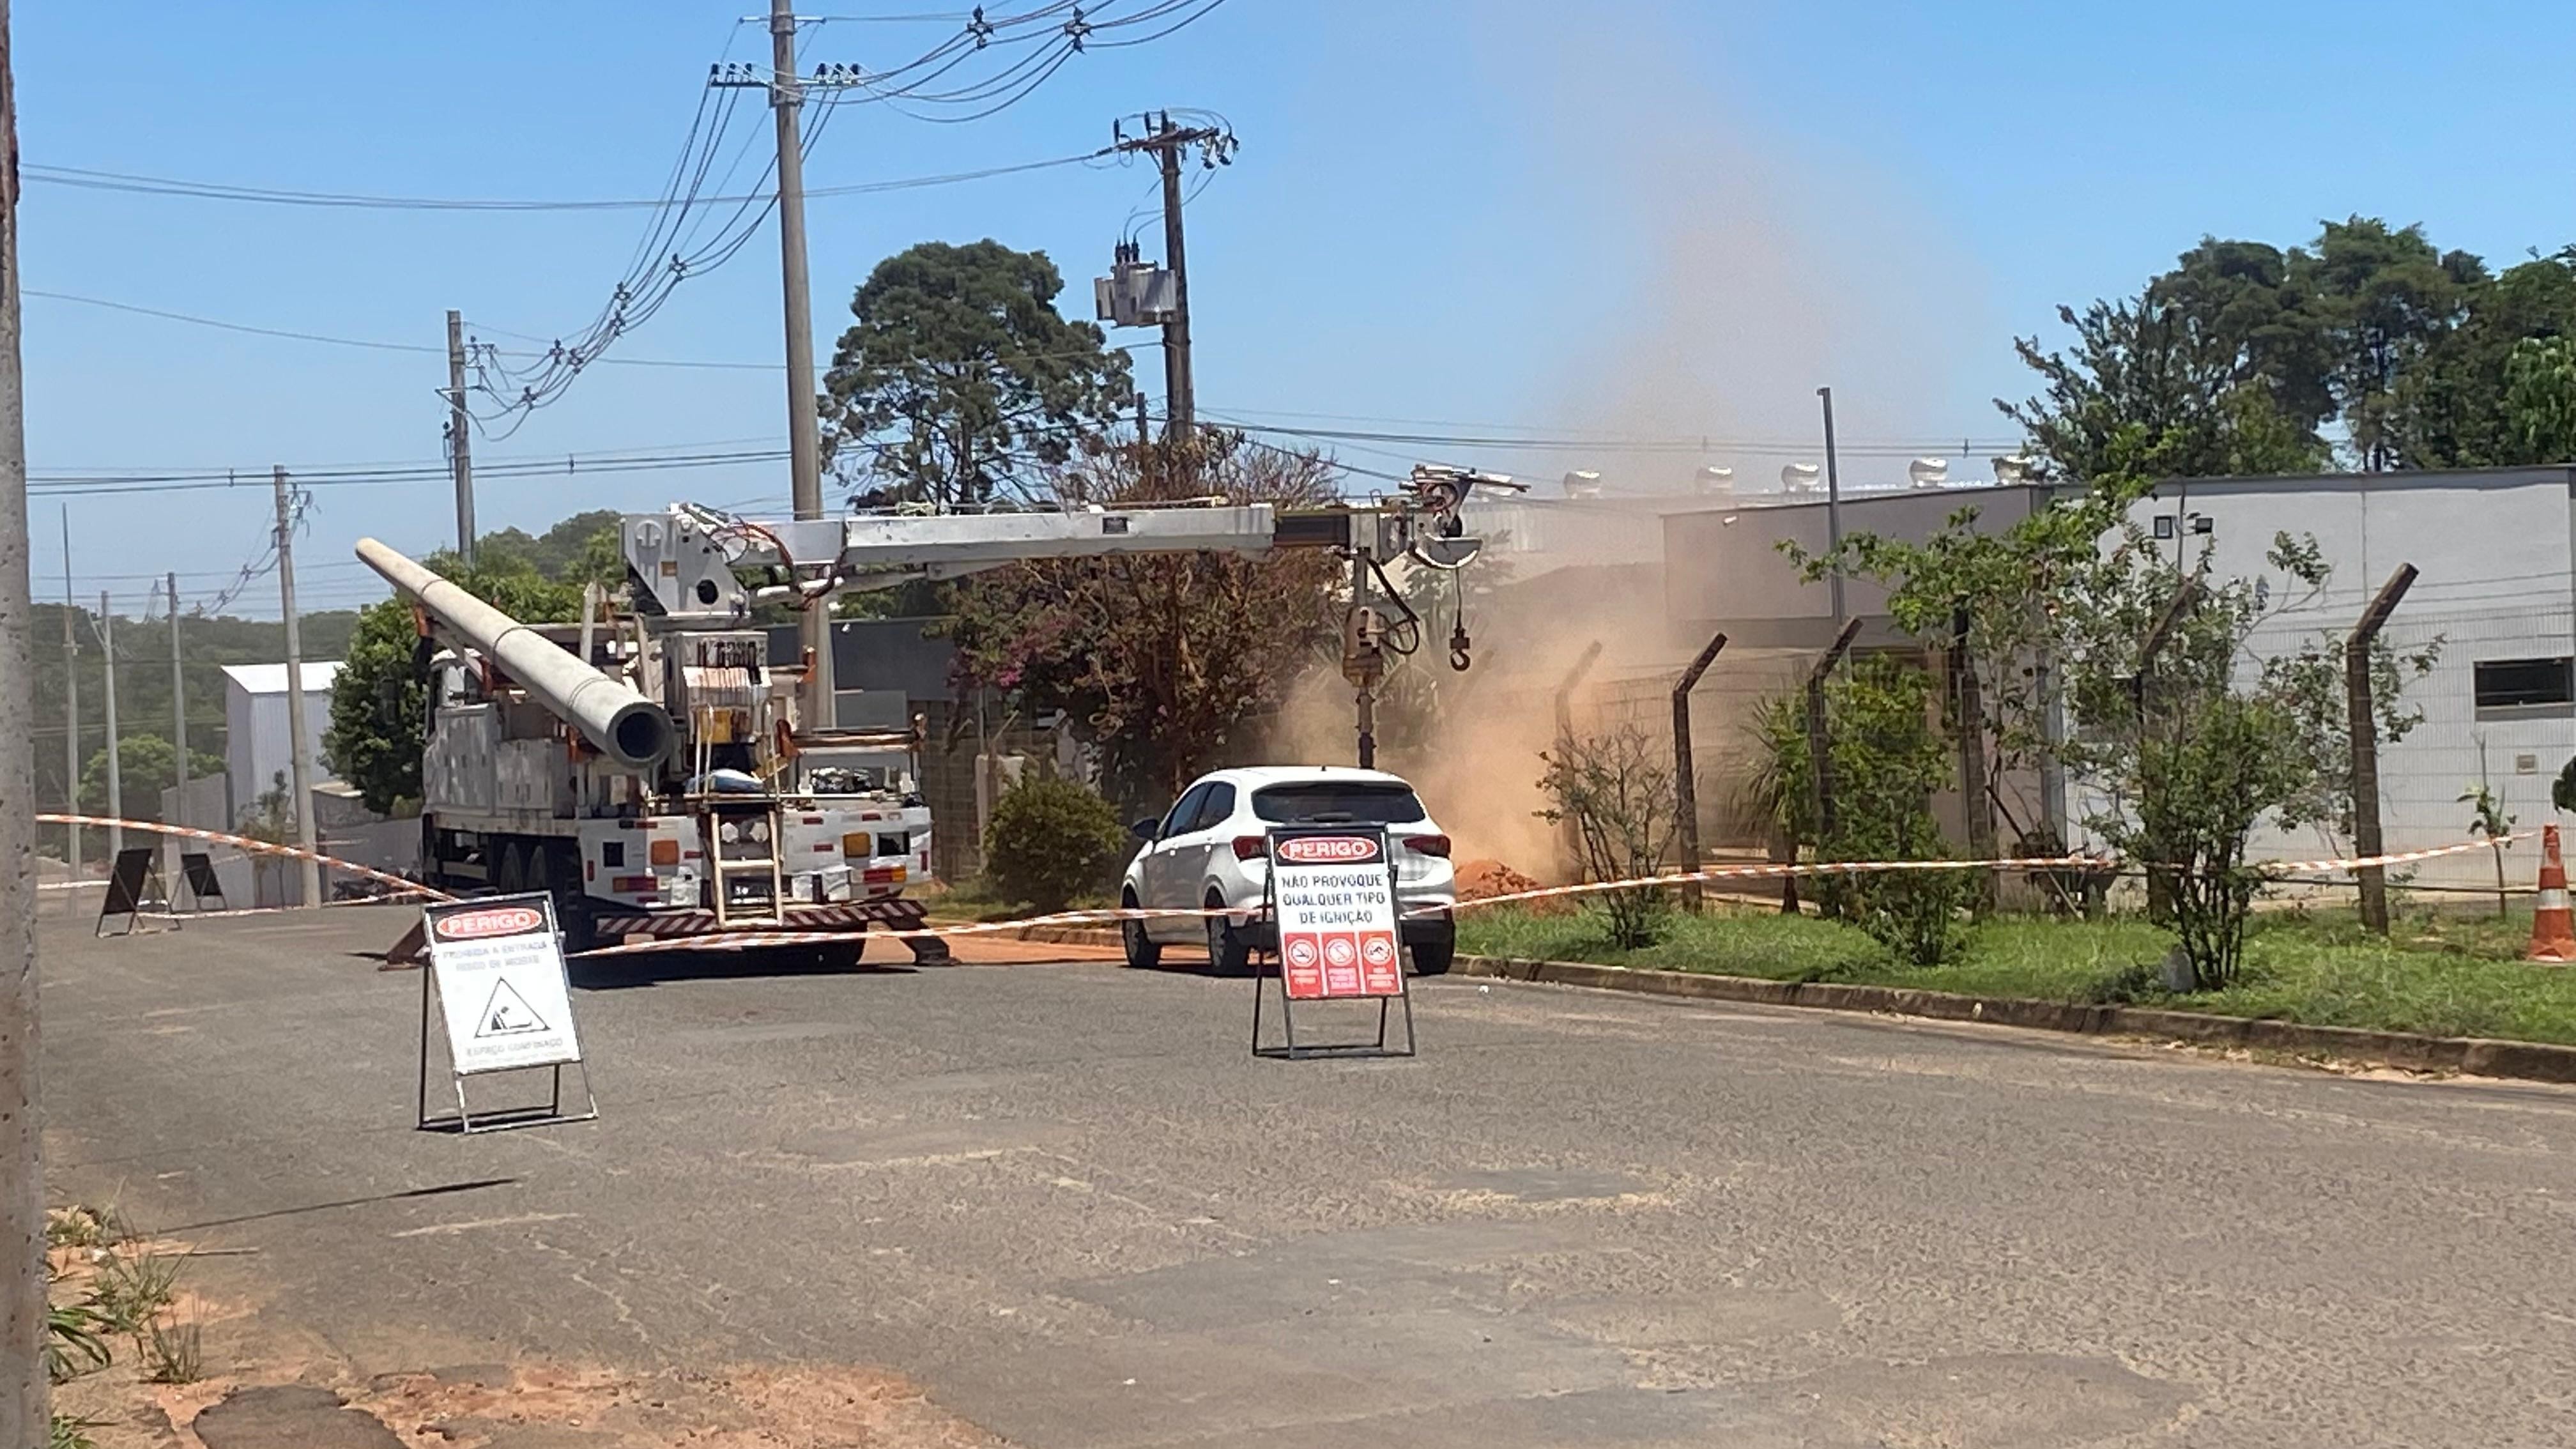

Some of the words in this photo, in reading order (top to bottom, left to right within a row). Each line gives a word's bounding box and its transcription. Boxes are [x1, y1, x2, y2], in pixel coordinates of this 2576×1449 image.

[1289, 841, 1368, 857] PERIGO
[1282, 873, 1308, 888] NÃO
[1313, 874, 1383, 888] PROVOQUE
[1283, 892, 1353, 906] QUALQUER
[1357, 892, 1385, 905] TIPO
[448, 912, 532, 934] PERIGO
[1300, 912, 1316, 924] DE
[1320, 910, 1373, 926] IGNIÇÃO
